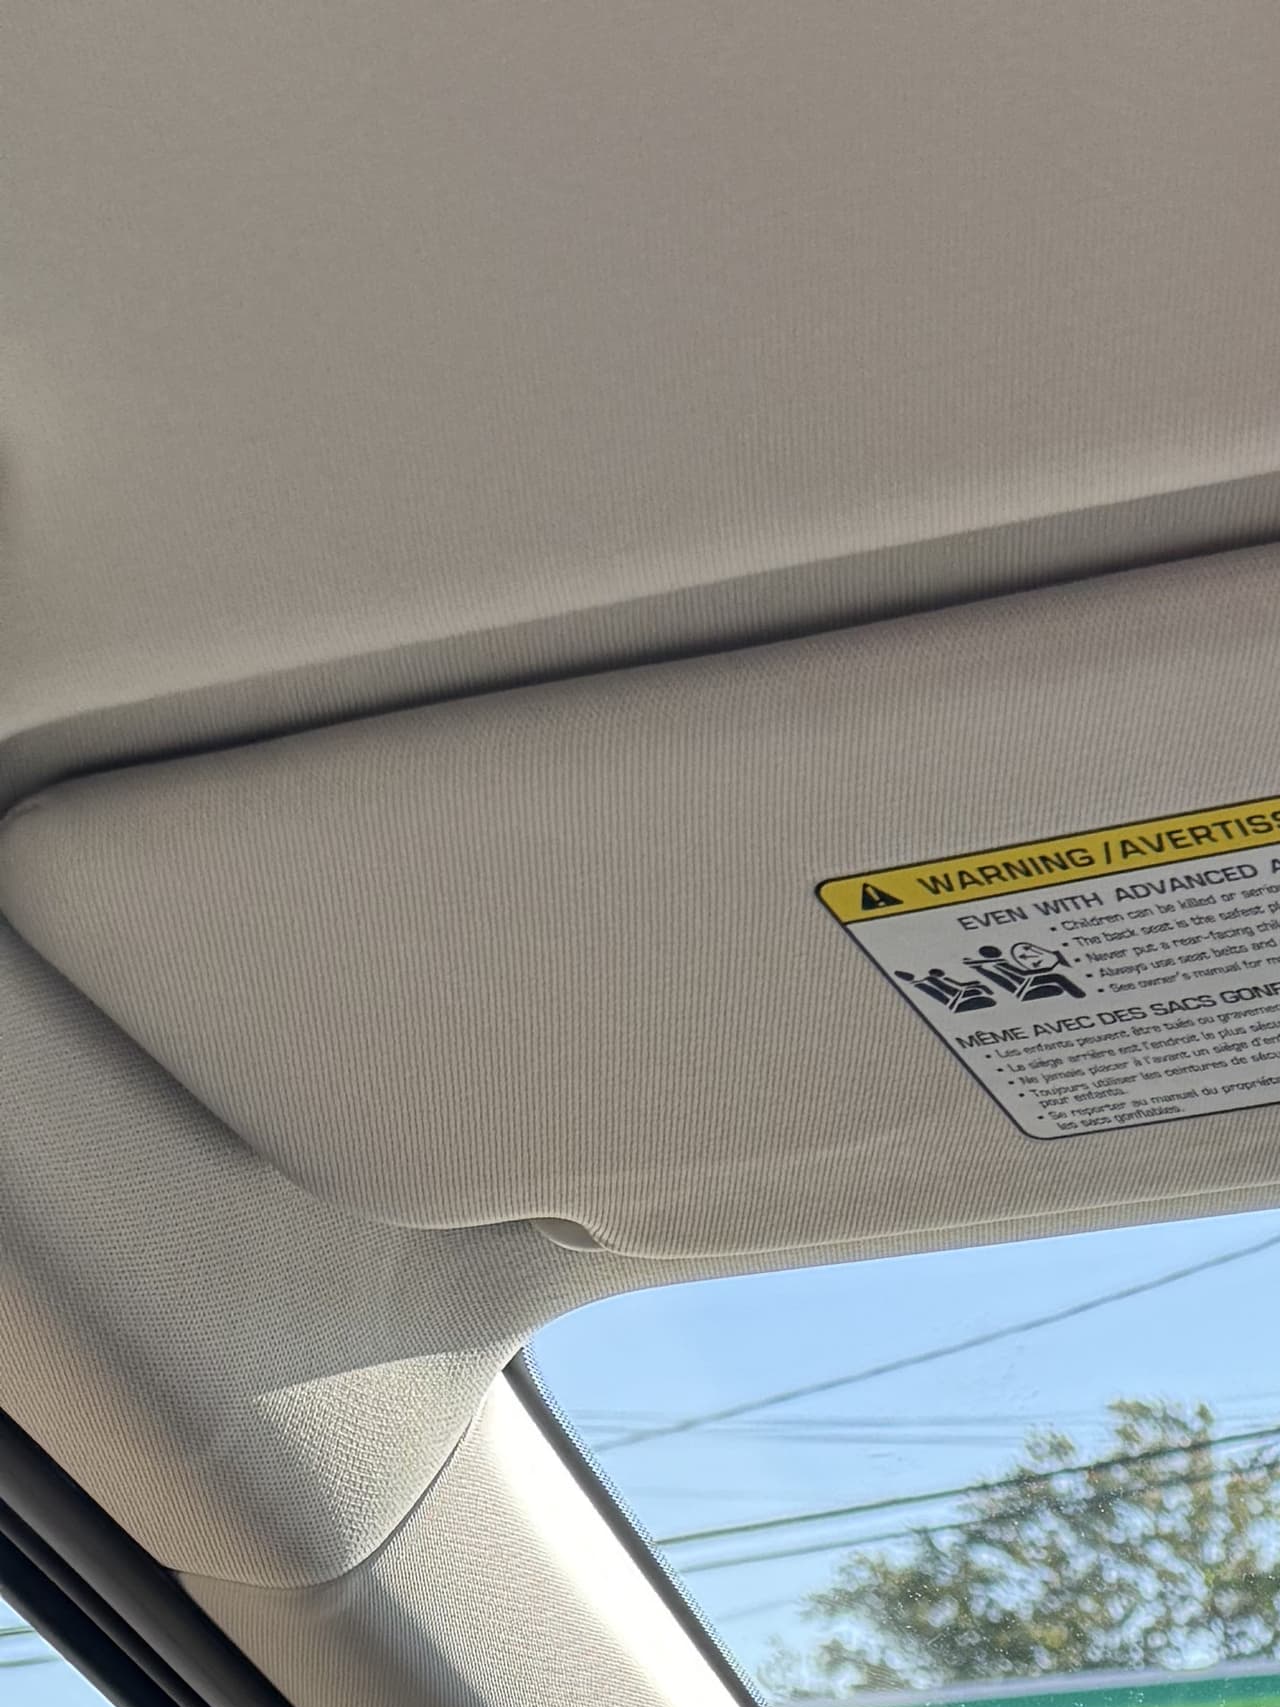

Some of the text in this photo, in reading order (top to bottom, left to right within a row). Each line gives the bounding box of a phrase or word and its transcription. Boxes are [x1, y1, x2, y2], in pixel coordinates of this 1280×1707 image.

[917, 848, 1093, 896] WARNING
[955, 905, 1029, 931] EVEN
[1031, 891, 1104, 916] WITH
[1114, 863, 1258, 902] ADVANCED
[953, 1026, 1030, 1049] MÊME
[1031, 1014, 1096, 1037] AVEC
[1095, 1006, 1148, 1026] DES
[1148, 993, 1218, 1016] SACS
